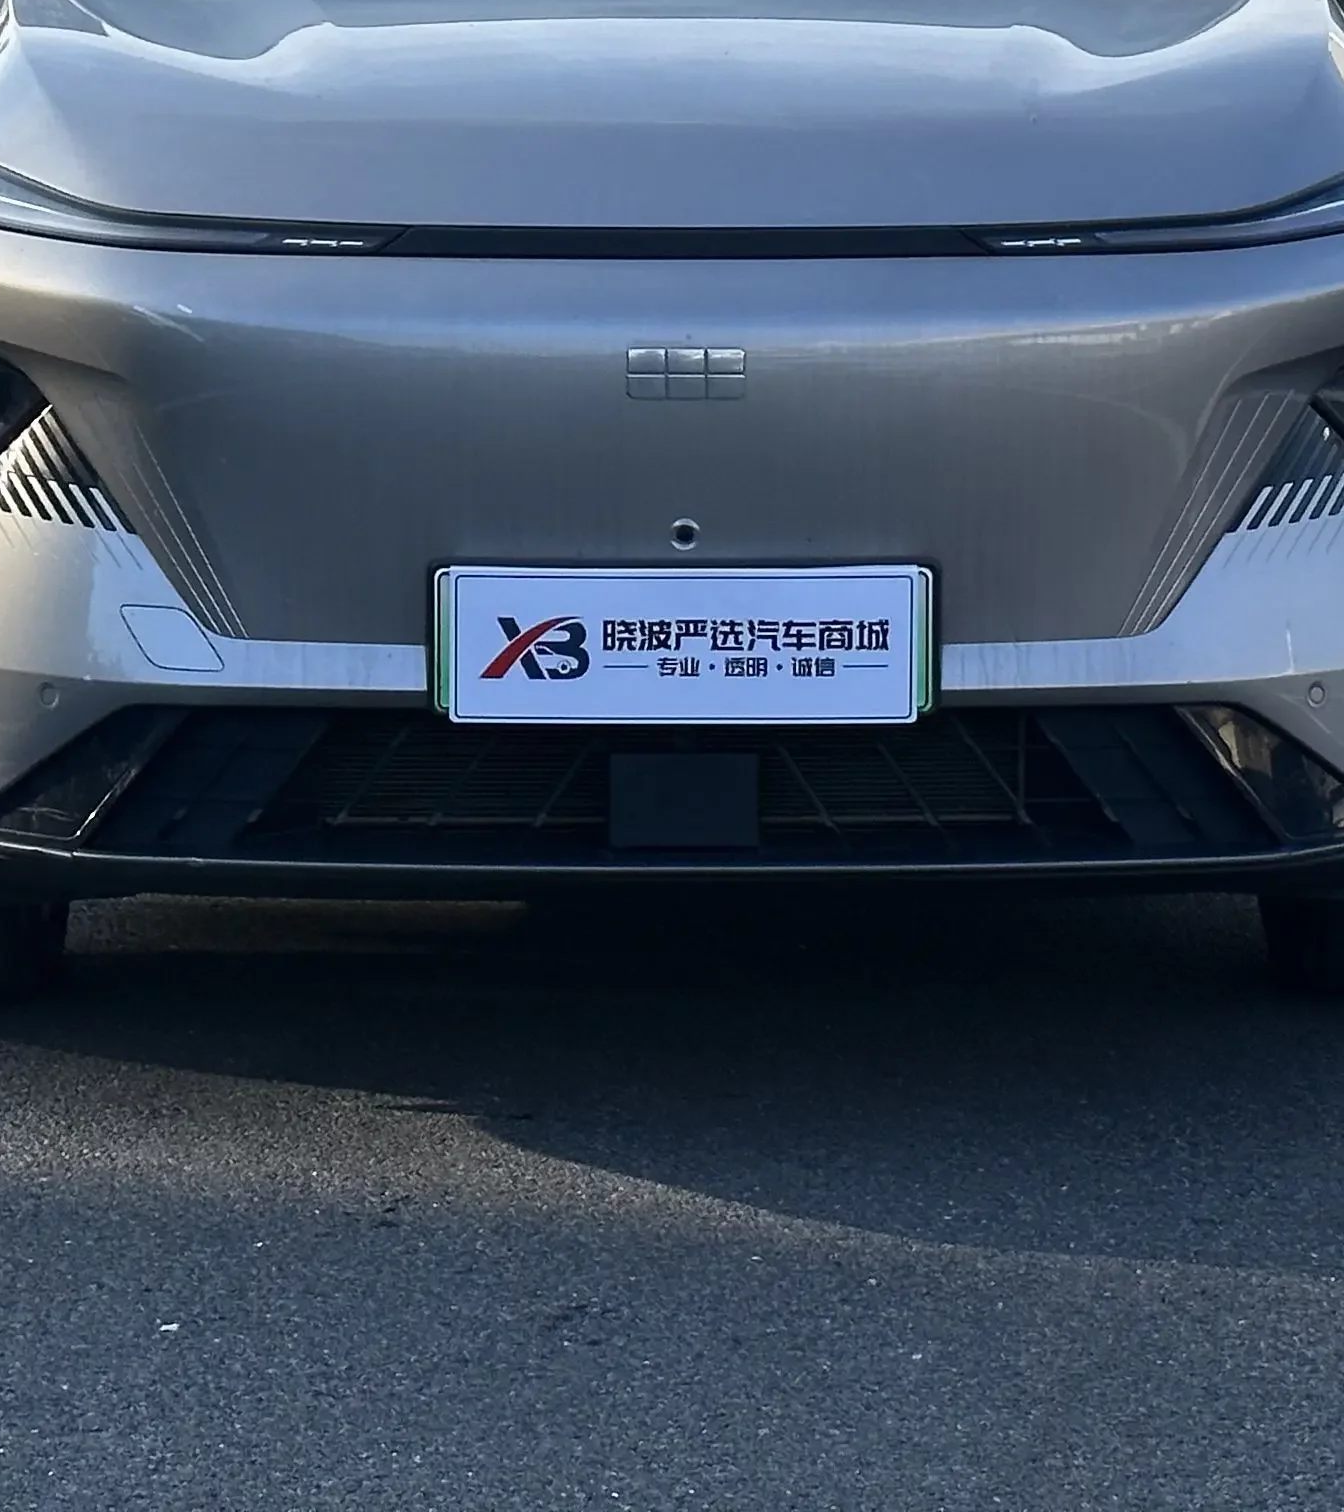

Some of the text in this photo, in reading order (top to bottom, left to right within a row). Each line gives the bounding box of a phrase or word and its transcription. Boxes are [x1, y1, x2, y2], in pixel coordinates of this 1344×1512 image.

[602, 618, 890, 653] 晓波严选汽车商城
